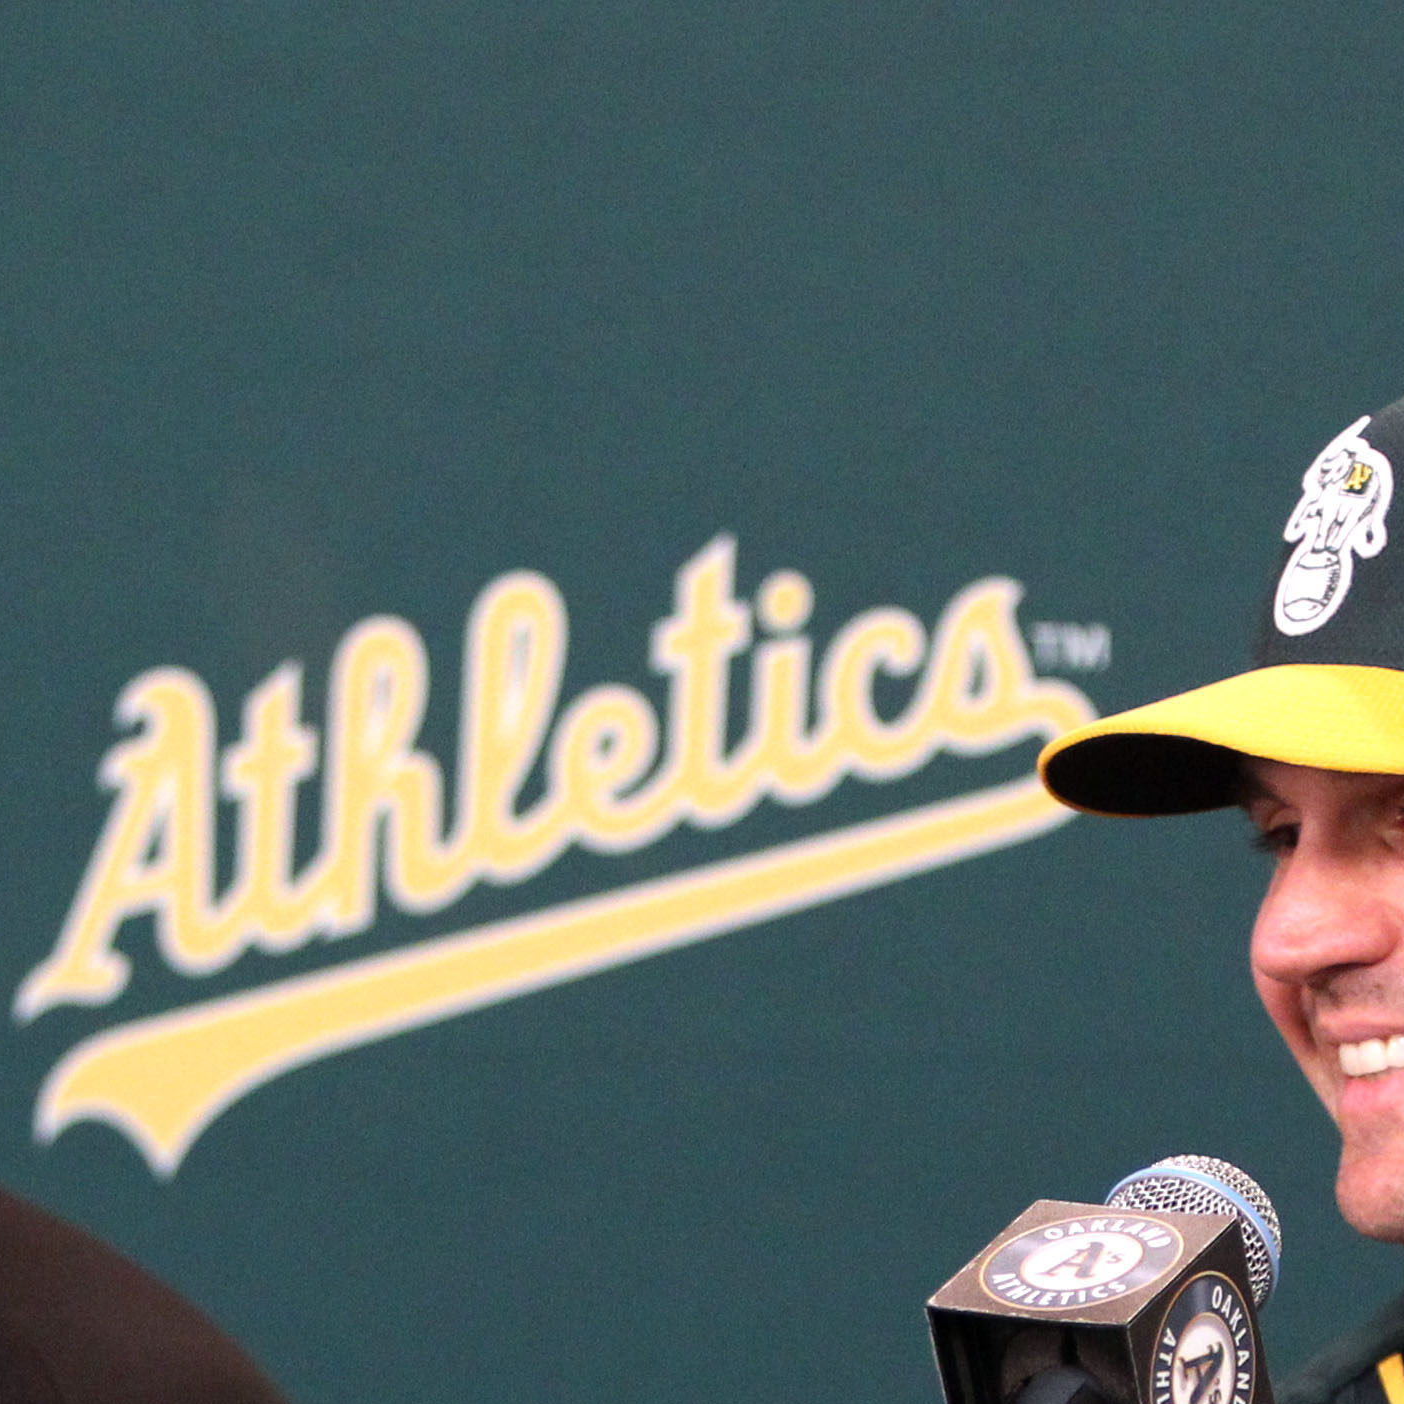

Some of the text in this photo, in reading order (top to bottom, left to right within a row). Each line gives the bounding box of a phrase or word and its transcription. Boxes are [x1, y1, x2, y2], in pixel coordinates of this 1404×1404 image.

[12, 533, 1066, 1026] Athletics
[1043, 1219, 1172, 1248] OAKLAND
[1035, 1241, 1126, 1279] A's
[991, 1272, 1127, 1306] ATHLETICS
